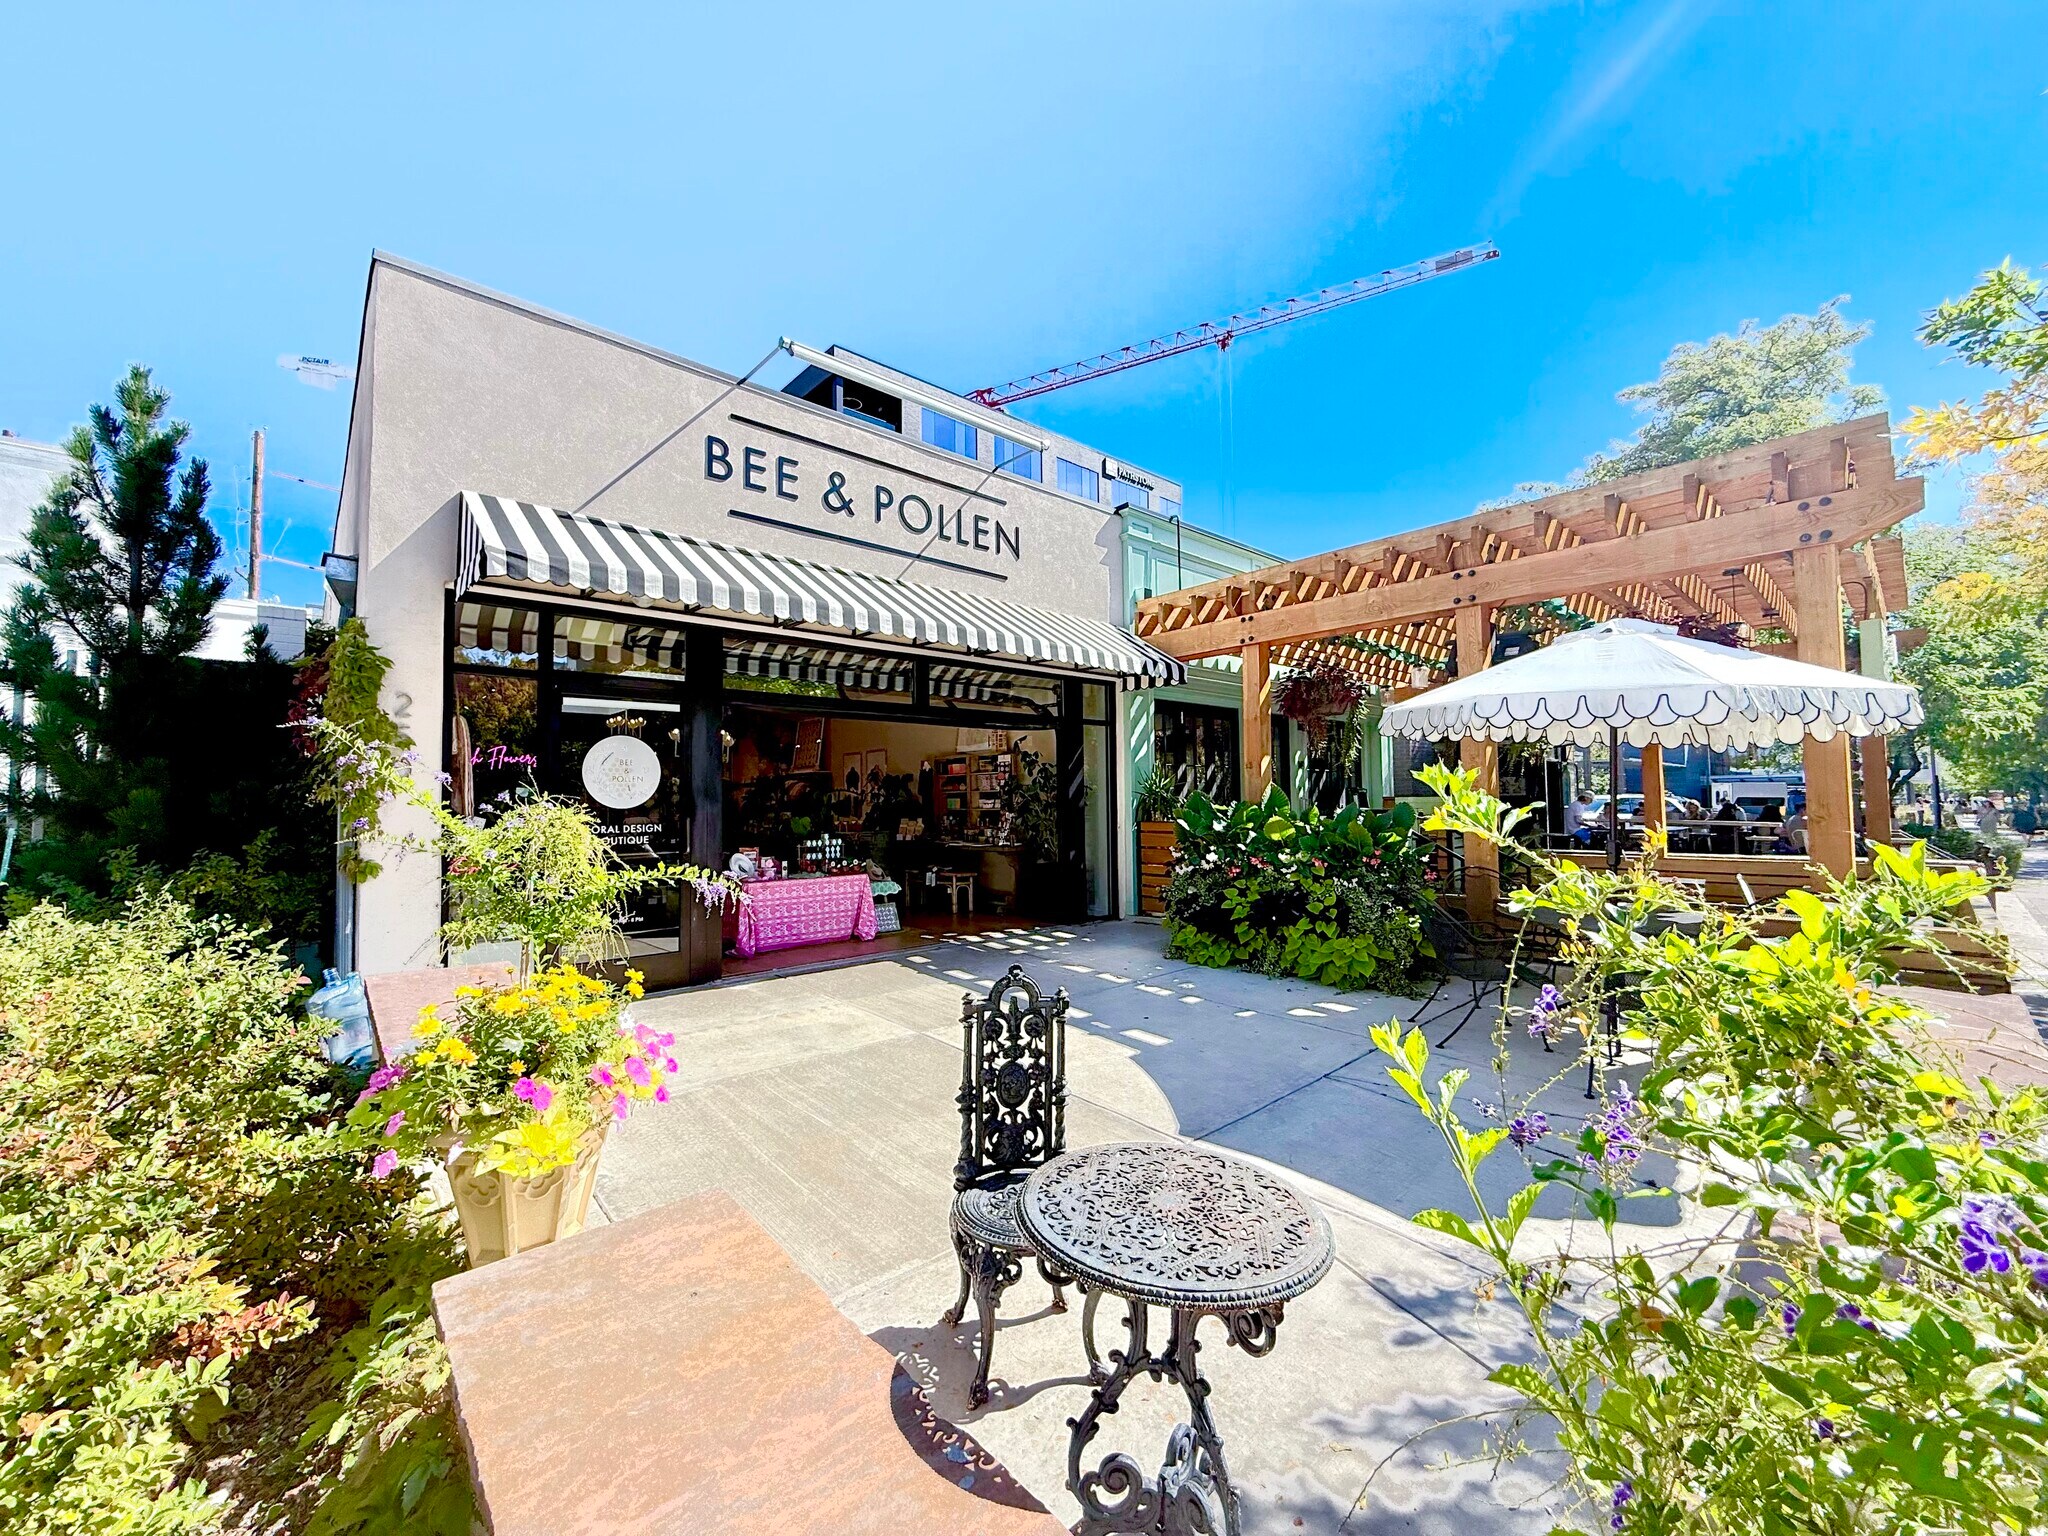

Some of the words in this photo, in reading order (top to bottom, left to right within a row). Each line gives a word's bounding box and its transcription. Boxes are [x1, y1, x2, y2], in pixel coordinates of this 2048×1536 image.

[704, 434, 799, 502] BEE
[821, 471, 855, 518] &
[874, 484, 1020, 562] POLLEN
[488, 745, 537, 770] Flowers
[611, 775, 644, 783] POLLEN
[591, 825, 620, 834] ORAL
[623, 824, 662, 833] DESIGN
[602, 835, 649, 845] OUTIQUE
